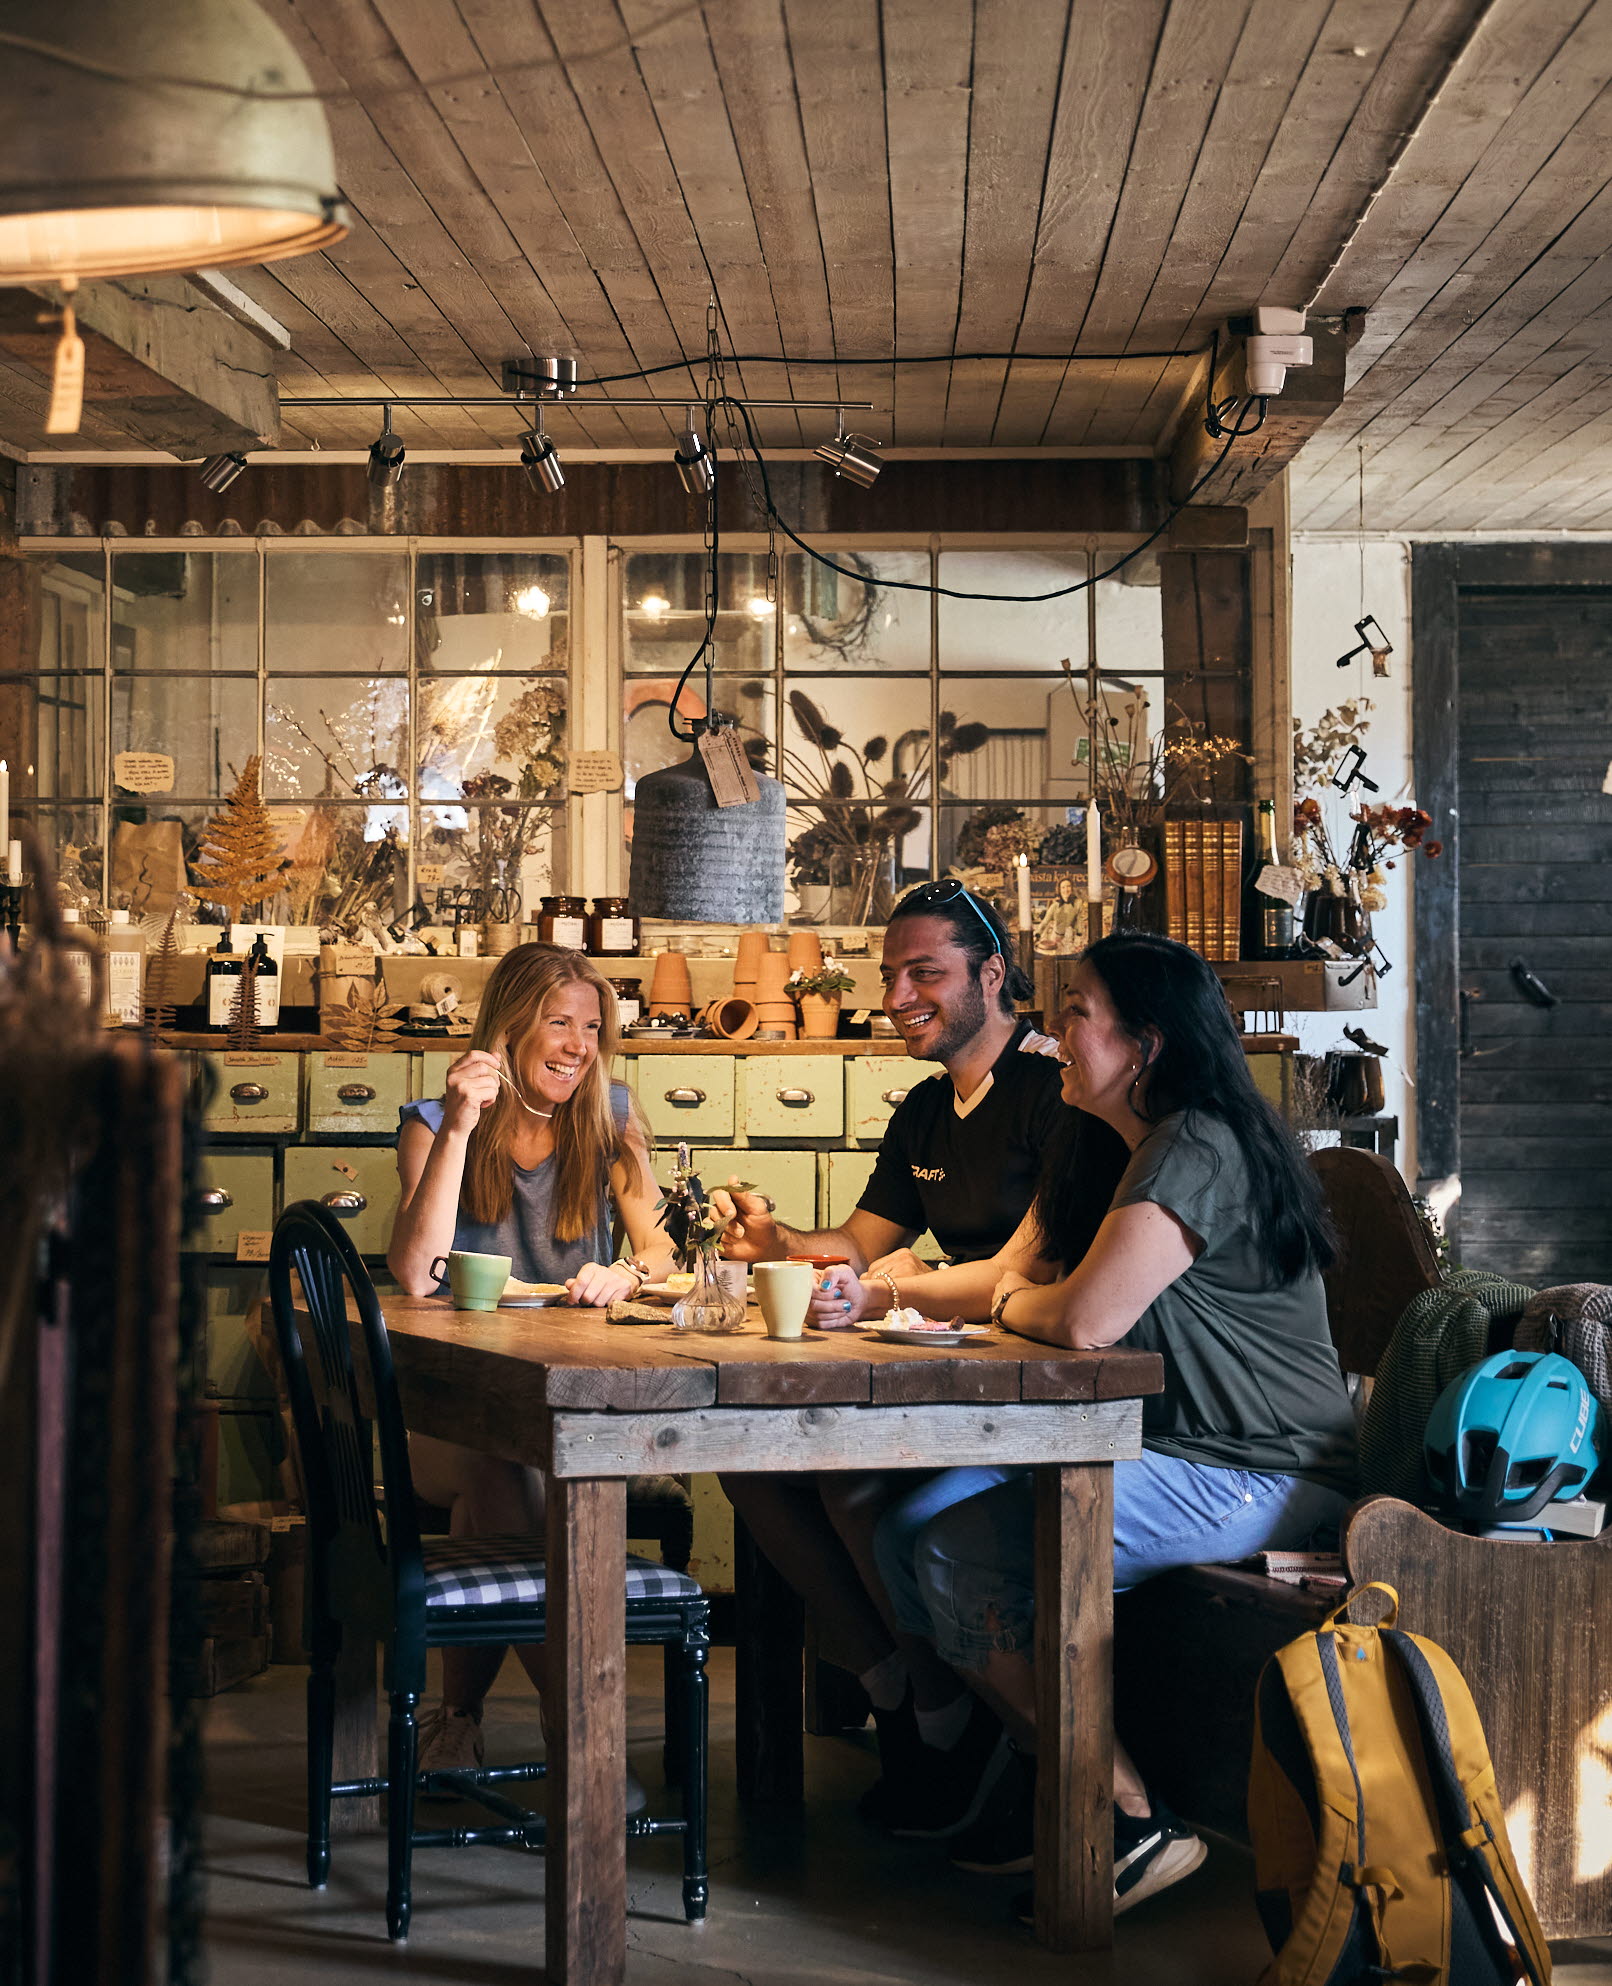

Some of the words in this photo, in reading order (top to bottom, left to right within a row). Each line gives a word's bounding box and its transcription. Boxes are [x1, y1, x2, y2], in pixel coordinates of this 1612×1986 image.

[1030, 870, 1053, 882] ästa
[911, 1164, 940, 1181] RAFT
[1570, 1387, 1590, 1454] CUBE
